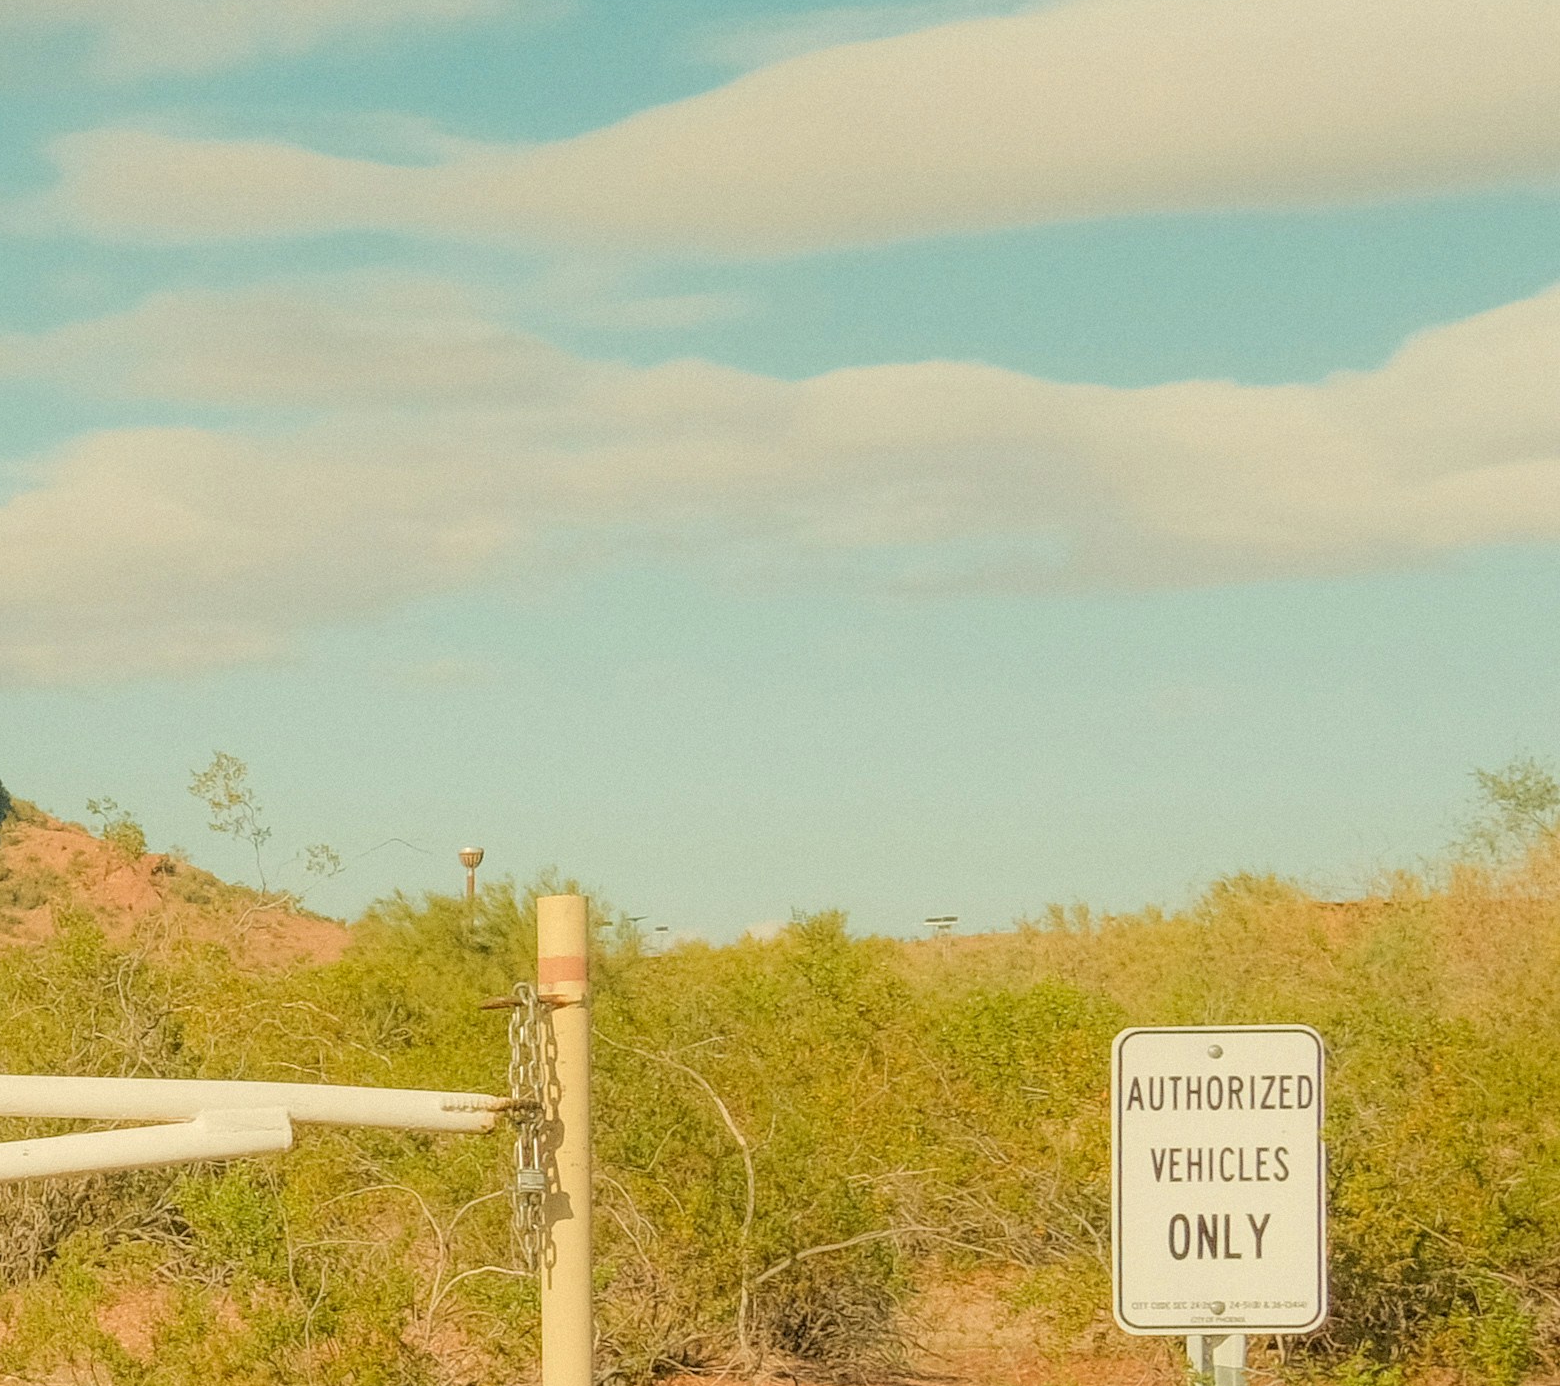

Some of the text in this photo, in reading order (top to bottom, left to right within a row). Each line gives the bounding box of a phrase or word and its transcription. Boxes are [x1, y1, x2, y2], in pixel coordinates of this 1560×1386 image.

[1126, 1075, 1313, 1111] AUTHORIZED
[1150, 1146, 1289, 1182] VEHICLES
[1169, 1213, 1271, 1260] ONLY
